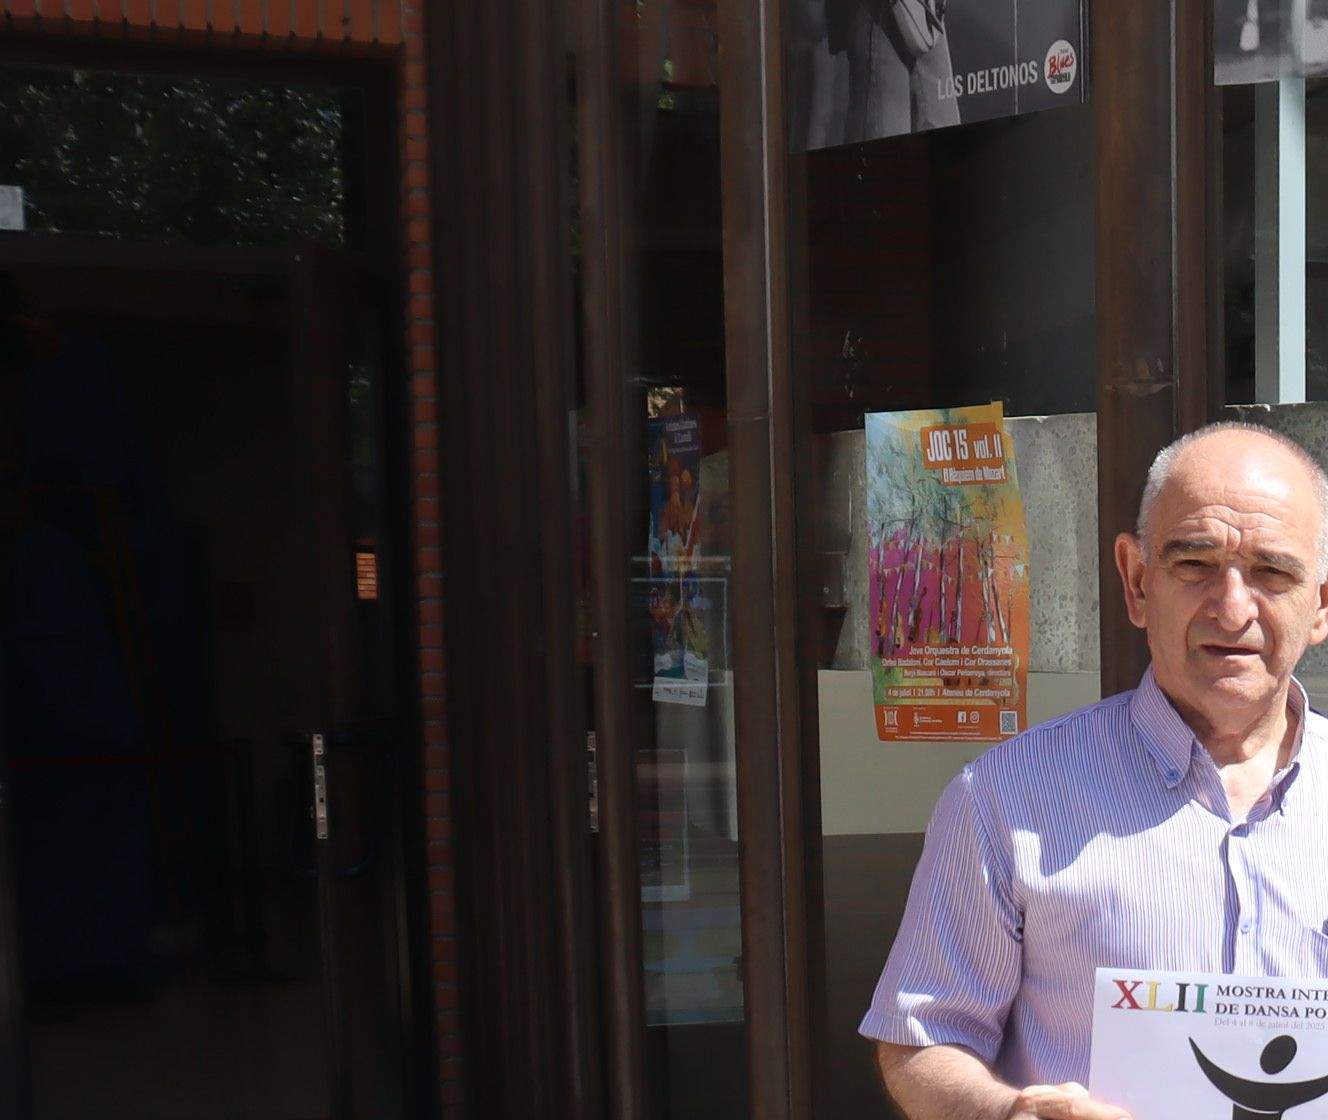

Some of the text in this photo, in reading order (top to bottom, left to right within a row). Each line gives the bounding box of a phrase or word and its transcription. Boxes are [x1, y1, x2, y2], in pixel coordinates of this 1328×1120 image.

[937, 61, 1039, 100] LOS DELTONOS
[927, 430, 953, 462] JOC
[953, 429, 969, 460] 15
[973, 433, 993, 460] vol.
[1110, 978, 1210, 1014] XLII
[1216, 983, 1287, 1000] MOSTRA
[1214, 1003, 1240, 1016] DE
[1244, 1004, 1300, 1019] DANSA
